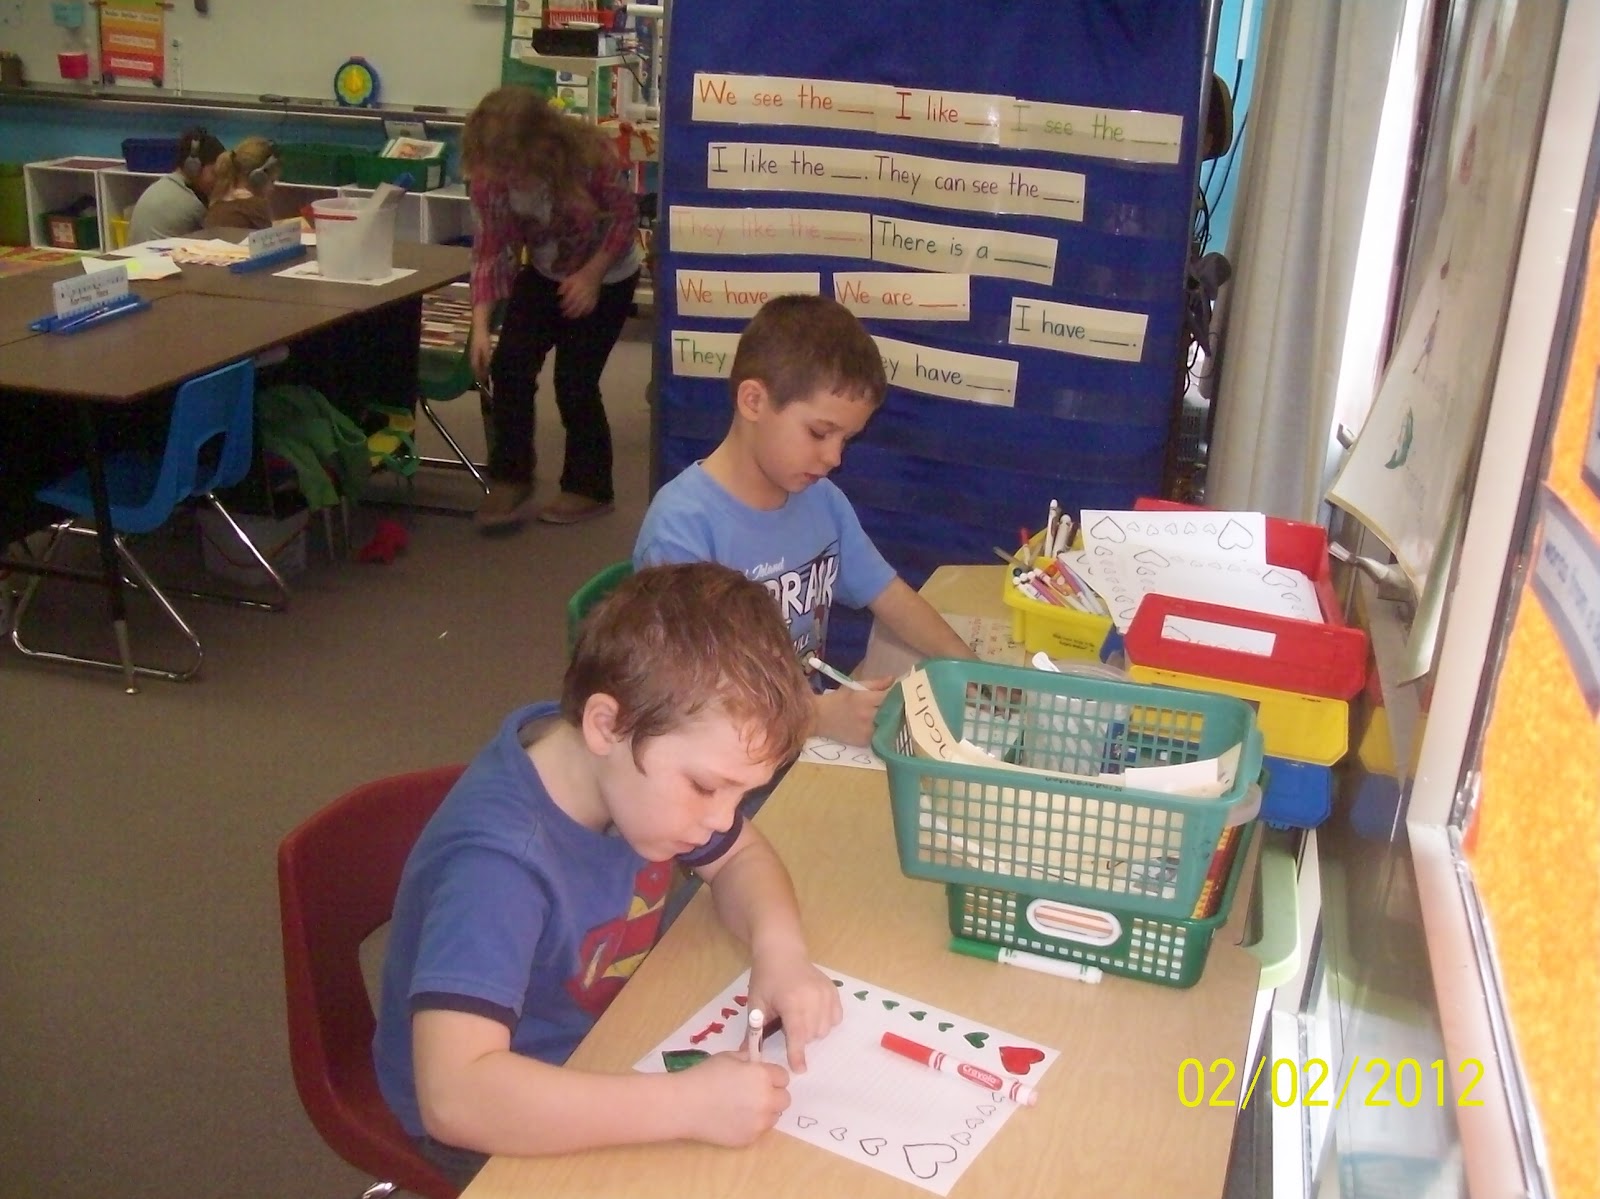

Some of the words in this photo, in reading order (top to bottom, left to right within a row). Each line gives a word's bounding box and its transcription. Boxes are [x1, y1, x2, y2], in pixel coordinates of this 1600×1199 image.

[699, 79, 737, 105] We
[751, 93, 783, 107] see
[797, 84, 833, 110] the
[895, 91, 912, 120] I
[927, 95, 959, 123] like
[1010, 104, 1031, 132] I
[1043, 118, 1074, 136] see
[1091, 113, 1125, 143] the
[711, 146, 728, 173] I
[743, 148, 778, 174] like
[790, 150, 825, 176] the
[874, 154, 921, 195] They
[934, 174, 966, 192] can
[972, 179, 999, 195] see
[1008, 172, 1040, 198] the
[671, 210, 726, 246] They
[741, 214, 777, 238] like
[790, 213, 821, 239] the
[877, 219, 937, 254] There
[949, 237, 963, 257] is
[976, 244, 989, 260] a
[679, 278, 712, 304] We
[724, 280, 769, 305] have
[835, 280, 870, 306] We
[881, 290, 914, 307] are
[1015, 304, 1031, 332] I
[1042, 309, 1086, 340] have
[674, 338, 727, 373] They
[915, 353, 964, 386] have
